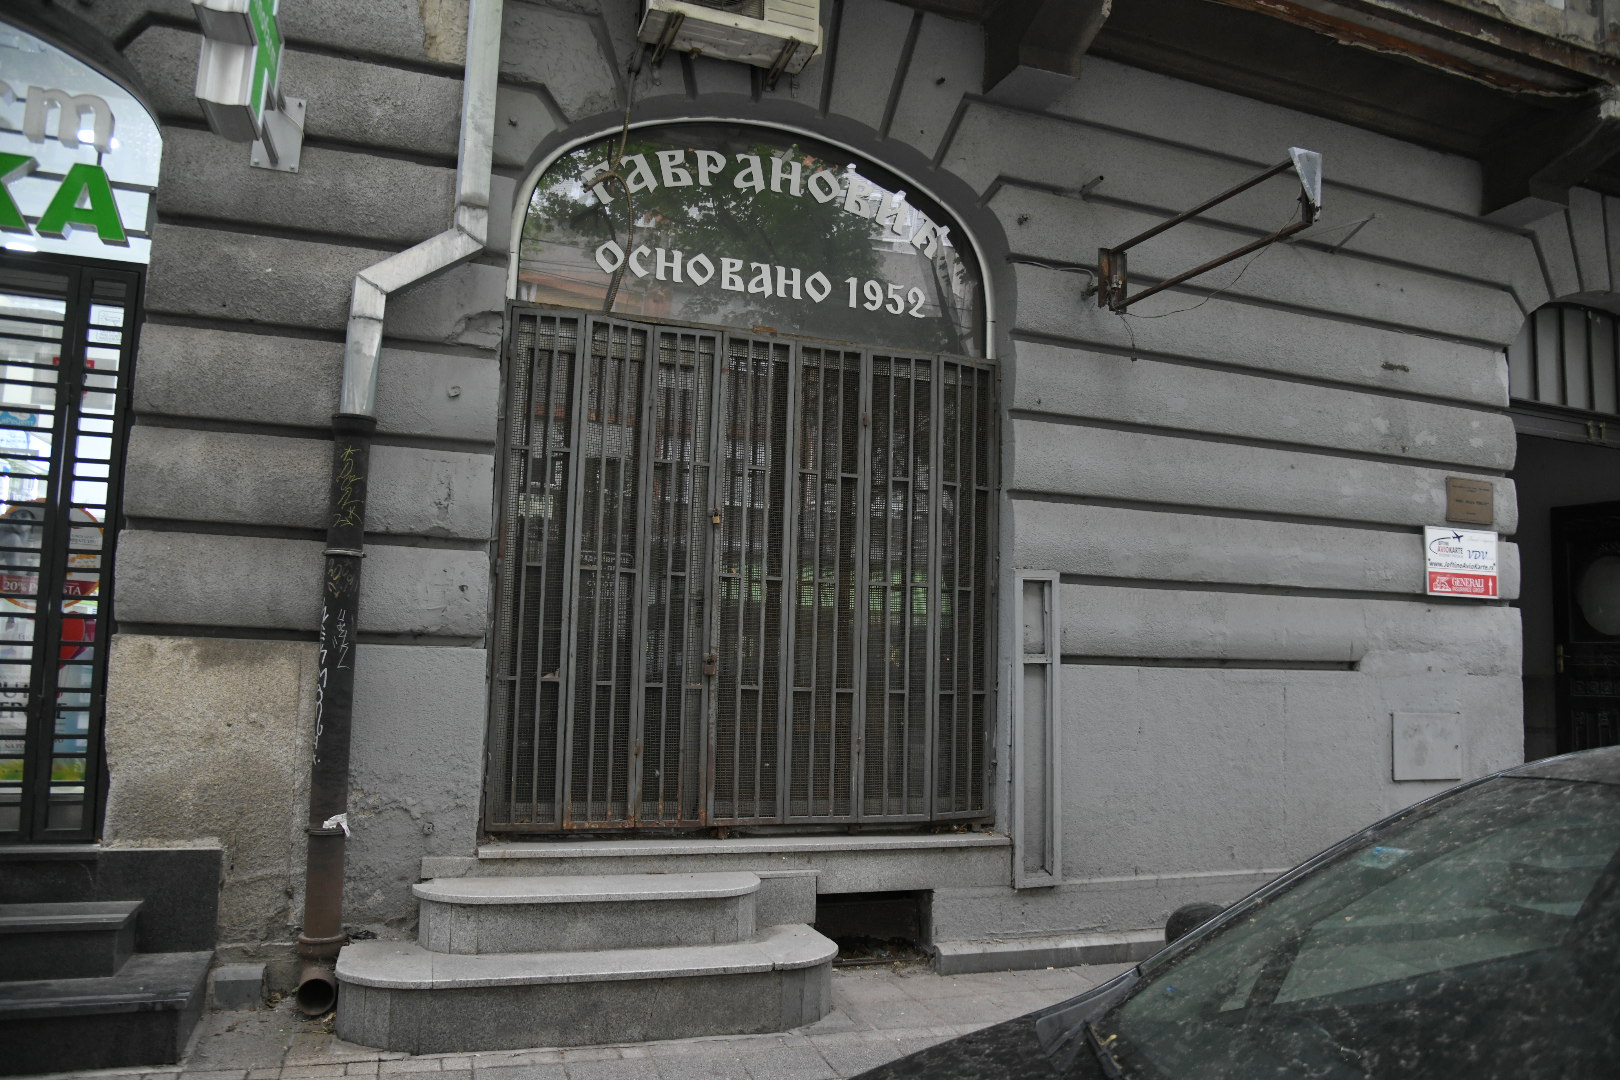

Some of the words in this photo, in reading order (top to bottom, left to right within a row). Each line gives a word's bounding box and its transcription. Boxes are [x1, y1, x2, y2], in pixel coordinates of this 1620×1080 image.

[582, 150, 943, 259] ГАВРАНОВИЋ
[595, 240, 831, 303] ОСНОВАНО
[845, 277, 926, 318] 1952
[1467, 549, 1488, 560] VDV
[3, 581, 26, 592] 20%
[1452, 577, 1484, 587] GENERALI
